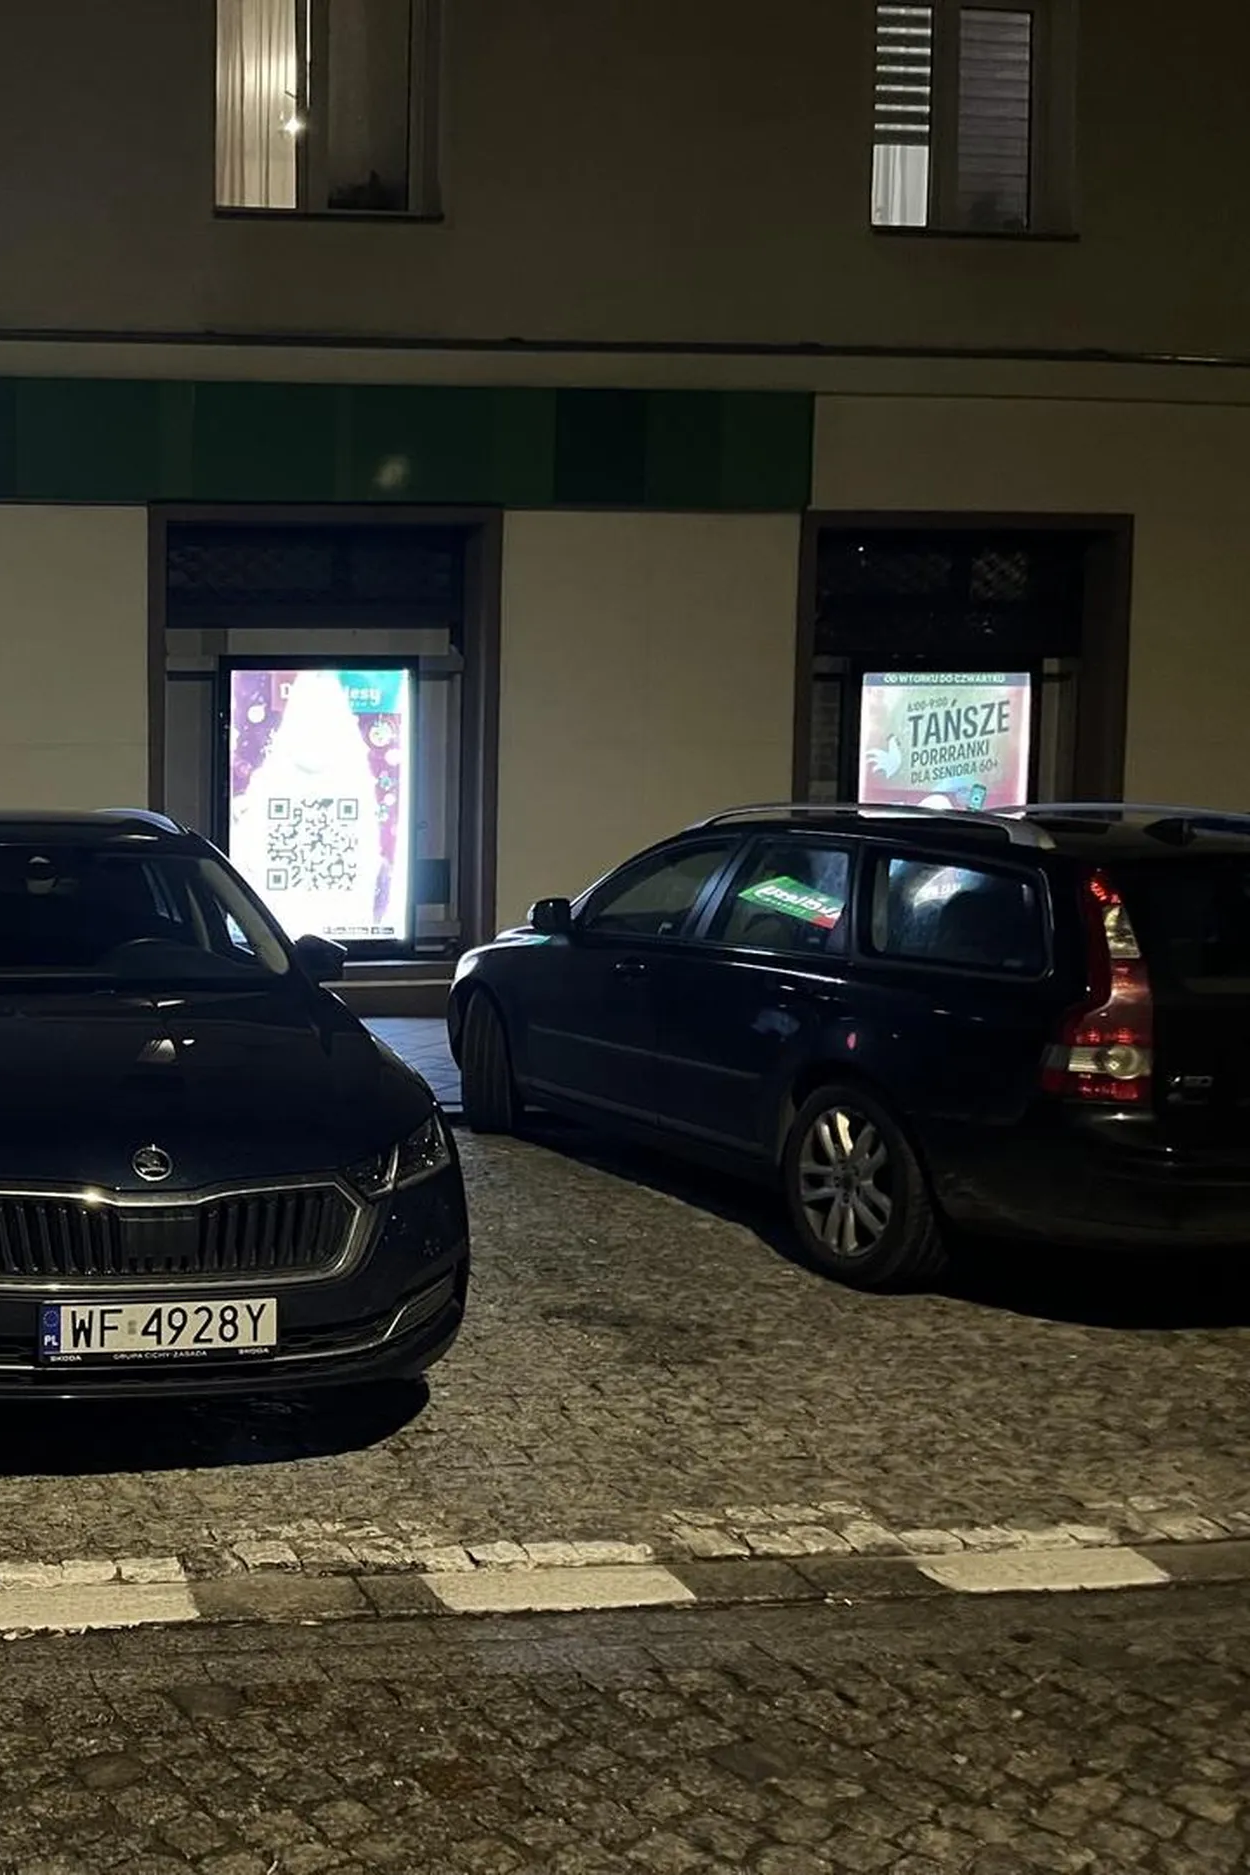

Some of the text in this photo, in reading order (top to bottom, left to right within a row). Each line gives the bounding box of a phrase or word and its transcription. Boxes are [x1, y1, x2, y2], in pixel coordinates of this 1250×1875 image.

[908, 698, 1010, 747] TAŃSZE
[910, 739, 990, 768] PORRRANKI
[910, 770, 931, 784] DLA
[932, 761, 977, 780] SENIORA
[71, 1303, 266, 1348] WF 4928Y
[44, 1335, 58, 1346] PL
